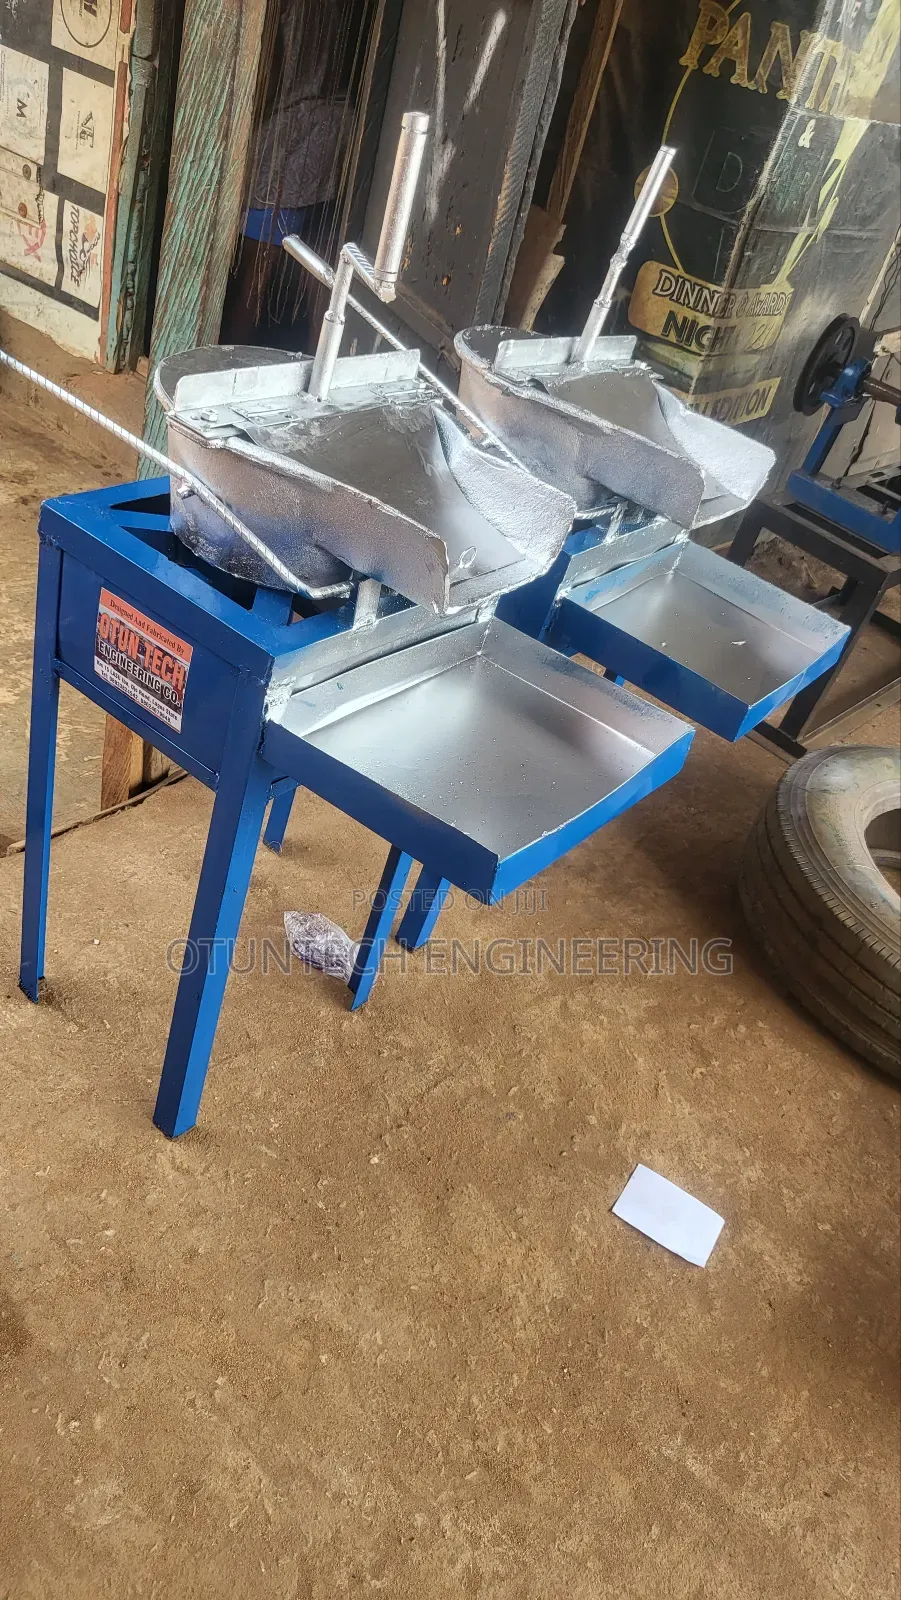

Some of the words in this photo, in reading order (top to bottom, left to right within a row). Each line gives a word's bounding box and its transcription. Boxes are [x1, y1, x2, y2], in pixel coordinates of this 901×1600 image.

[69, 204, 80, 287] TOPCHOICE
[652, 269, 734, 318] DINNER
[660, 309, 738, 353] NIGHT
[99, 612, 140, 660] OTUN
[143, 641, 186, 691] TECH
[110, 599, 134, 620] Designed
[134, 615, 146, 628] And
[147, 624, 176, 649] Fabricated
[176, 643, 185, 655] By
[99, 641, 161, 692] ENGINEERING
[163, 686, 181, 707] CO.
